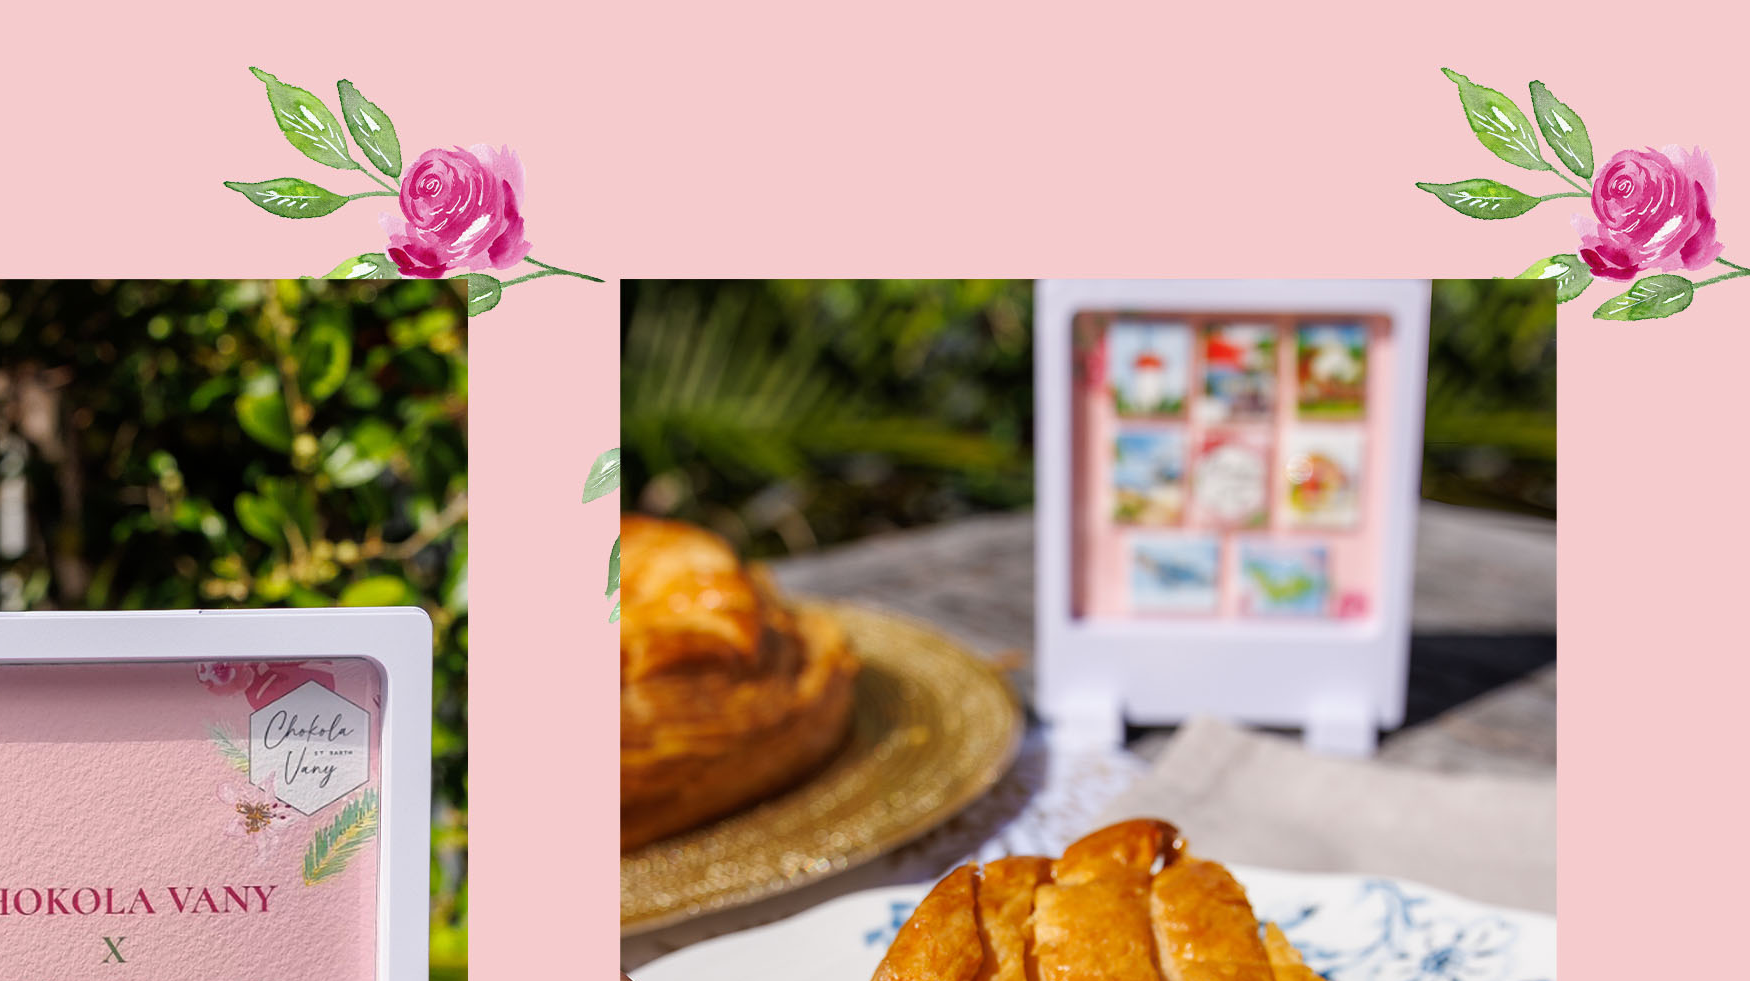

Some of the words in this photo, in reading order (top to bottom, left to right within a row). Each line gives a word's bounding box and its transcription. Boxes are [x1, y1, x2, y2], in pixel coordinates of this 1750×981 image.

[264, 710, 354, 749] Chokola
[284, 746, 338, 789] Vany
[167, 885, 279, 914] VANY
[102, 936, 128, 964] X
